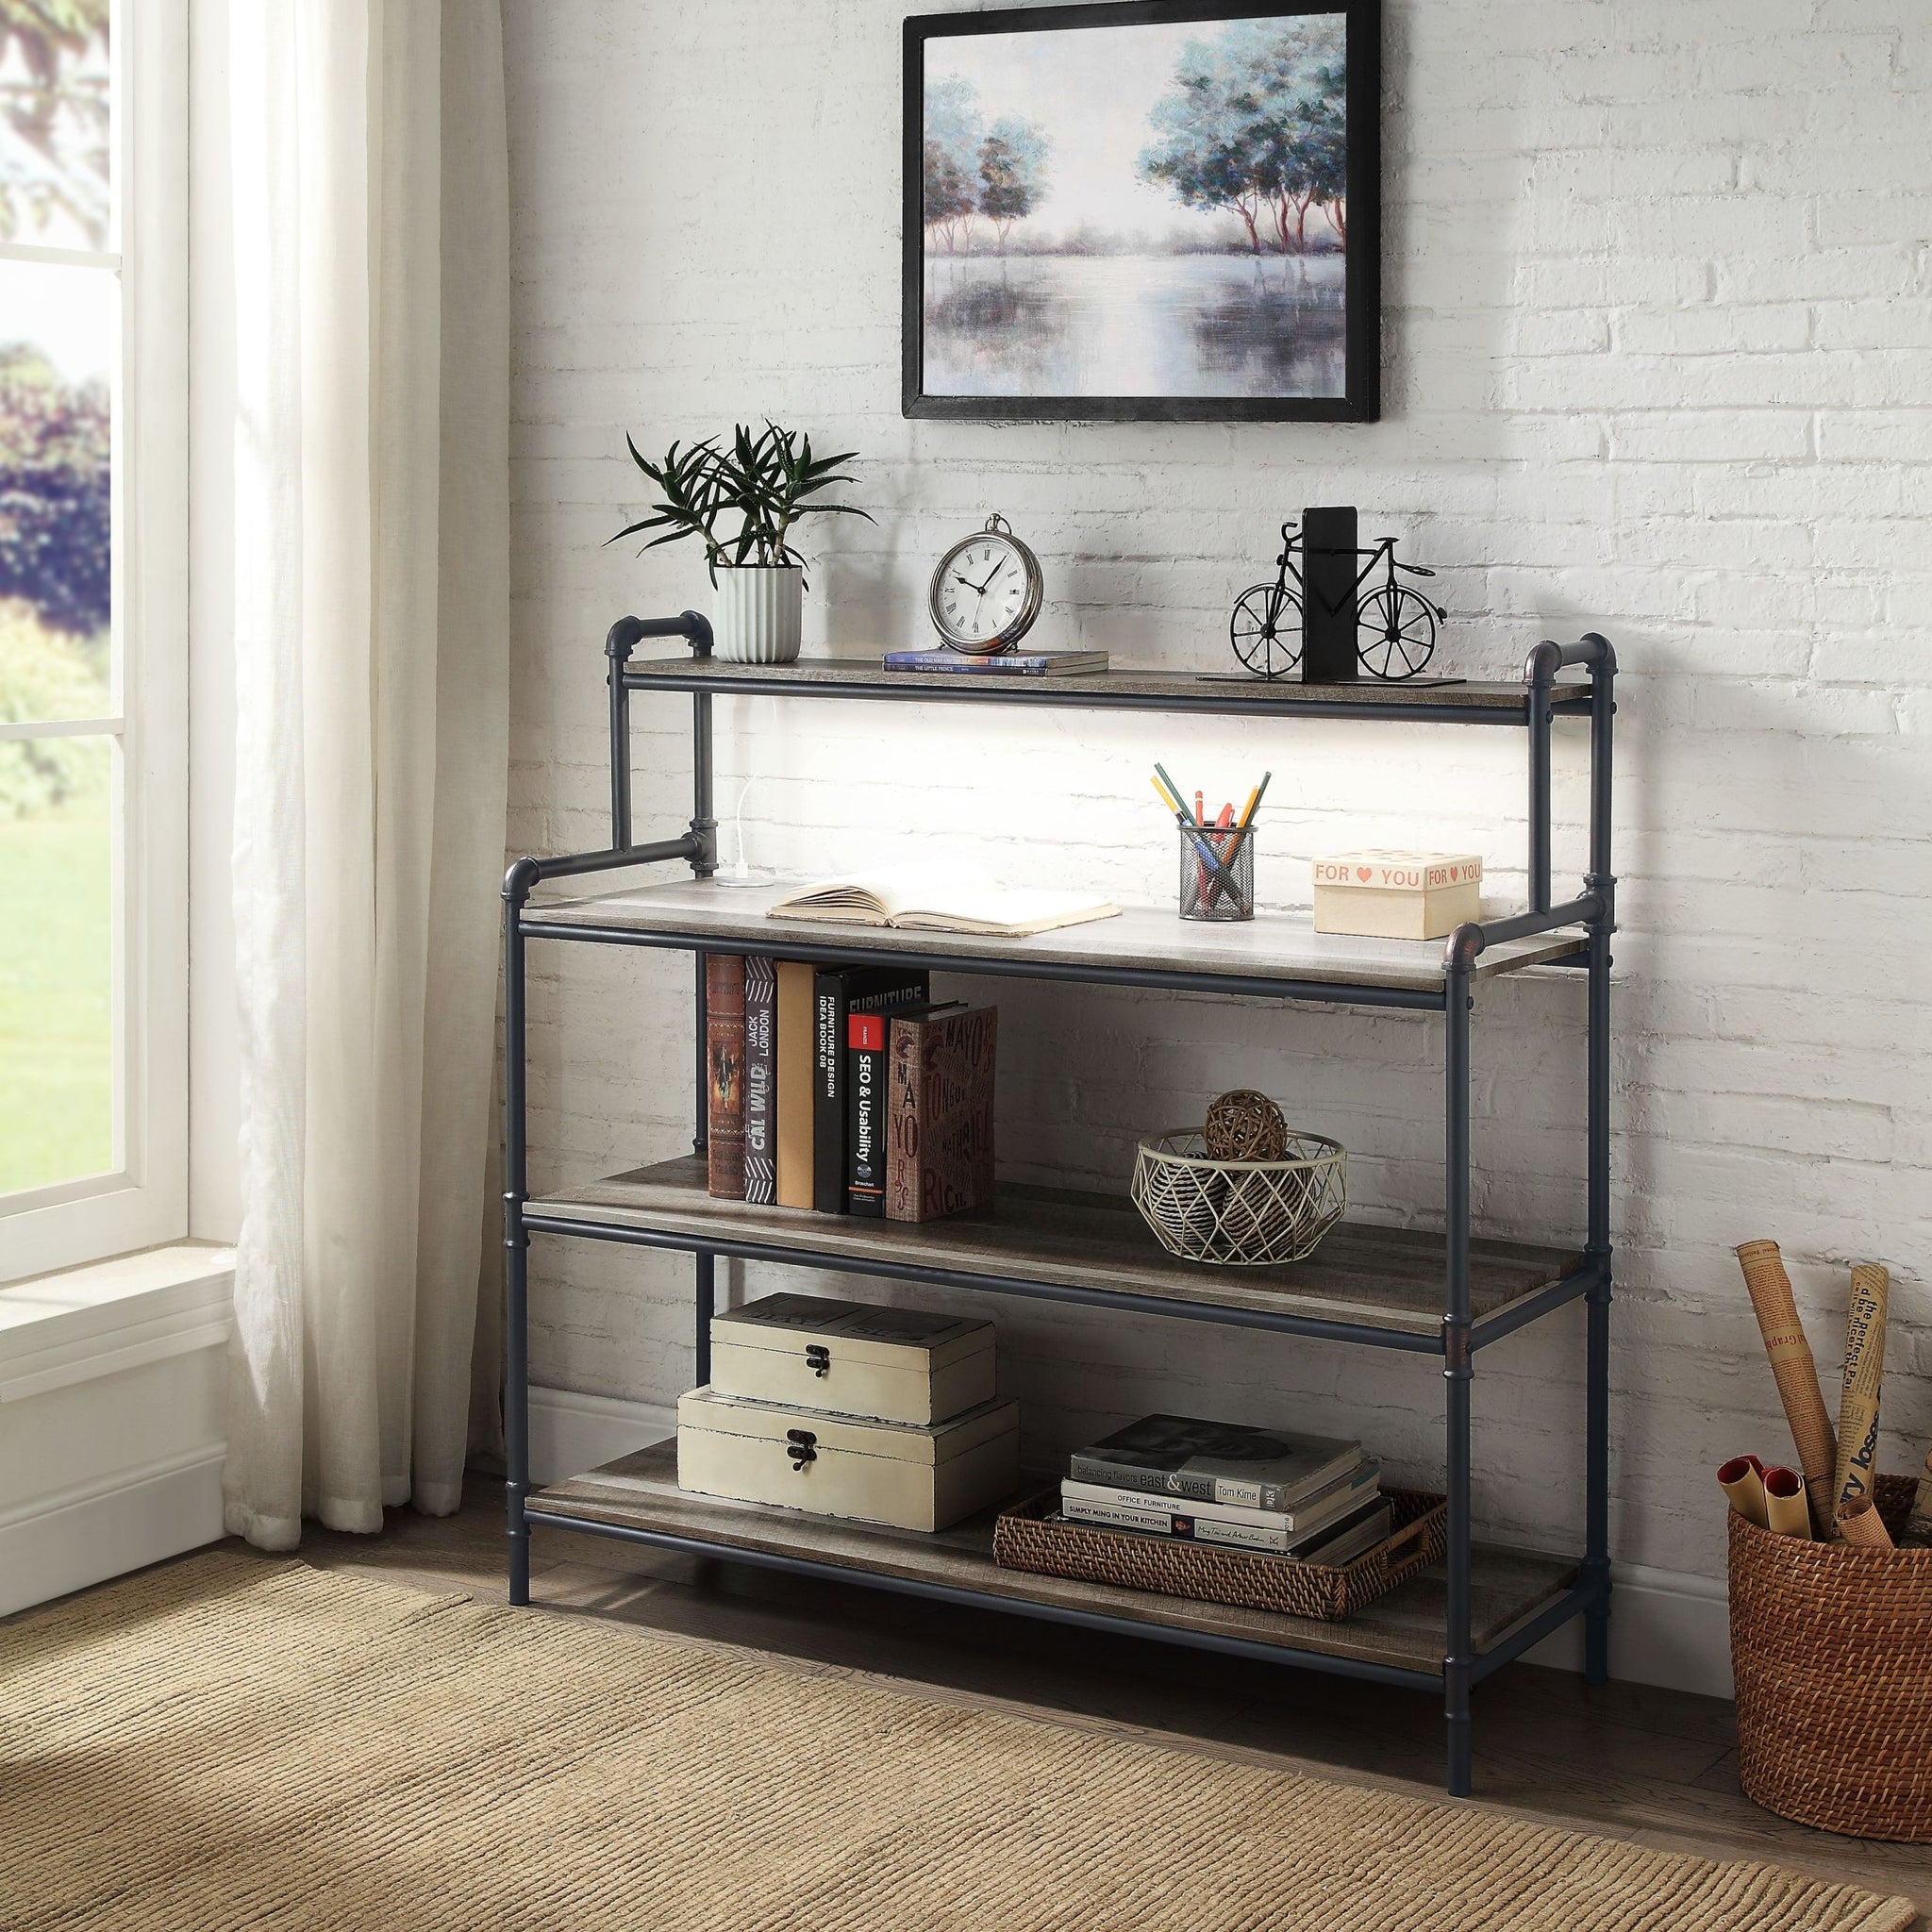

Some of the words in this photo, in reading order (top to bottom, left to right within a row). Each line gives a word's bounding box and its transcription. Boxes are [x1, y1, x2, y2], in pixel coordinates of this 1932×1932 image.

[1315, 864, 1349, 881] FOR
[1382, 869, 1419, 887] YOU
[1429, 869, 1447, 885] FOR
[1462, 863, 1481, 880] YOU
[749, 1016, 758, 1046] JACK
[759, 1009, 769, 1057] LONDON
[820, 1056, 827, 1068] 08
[859, 1055, 872, 1084] SEO
[859, 1086, 872, 1098] &
[857, 1101, 872, 1162] Usability
[1857, 1298, 1868, 1312] be
[1863, 1301, 1877, 1319] the
[1848, 1317, 1860, 1349] nicer
[1849, 1322, 1869, 1367] perfect
[1077, 1465, 1112, 1480] balancing
[1113, 1471, 1138, 1483] flavors
[1218, 1485, 1235, 1497] Tom
[1237, 1488, 1257, 1501] Kime
[1840, 1473, 1865, 1504] ry
[1118, 1495, 1141, 1505] OFFICE
[1143, 1499, 1181, 1511] FURNITURE
[1069, 1506, 1091, 1515] SIMPLY
[1092, 1509, 1111, 1518] MING
[1121, 1514, 1140, 1523] YOUR
[1140, 1516, 1168, 1527] KITCHEN
[1269, 1536, 1279, 1546] K
